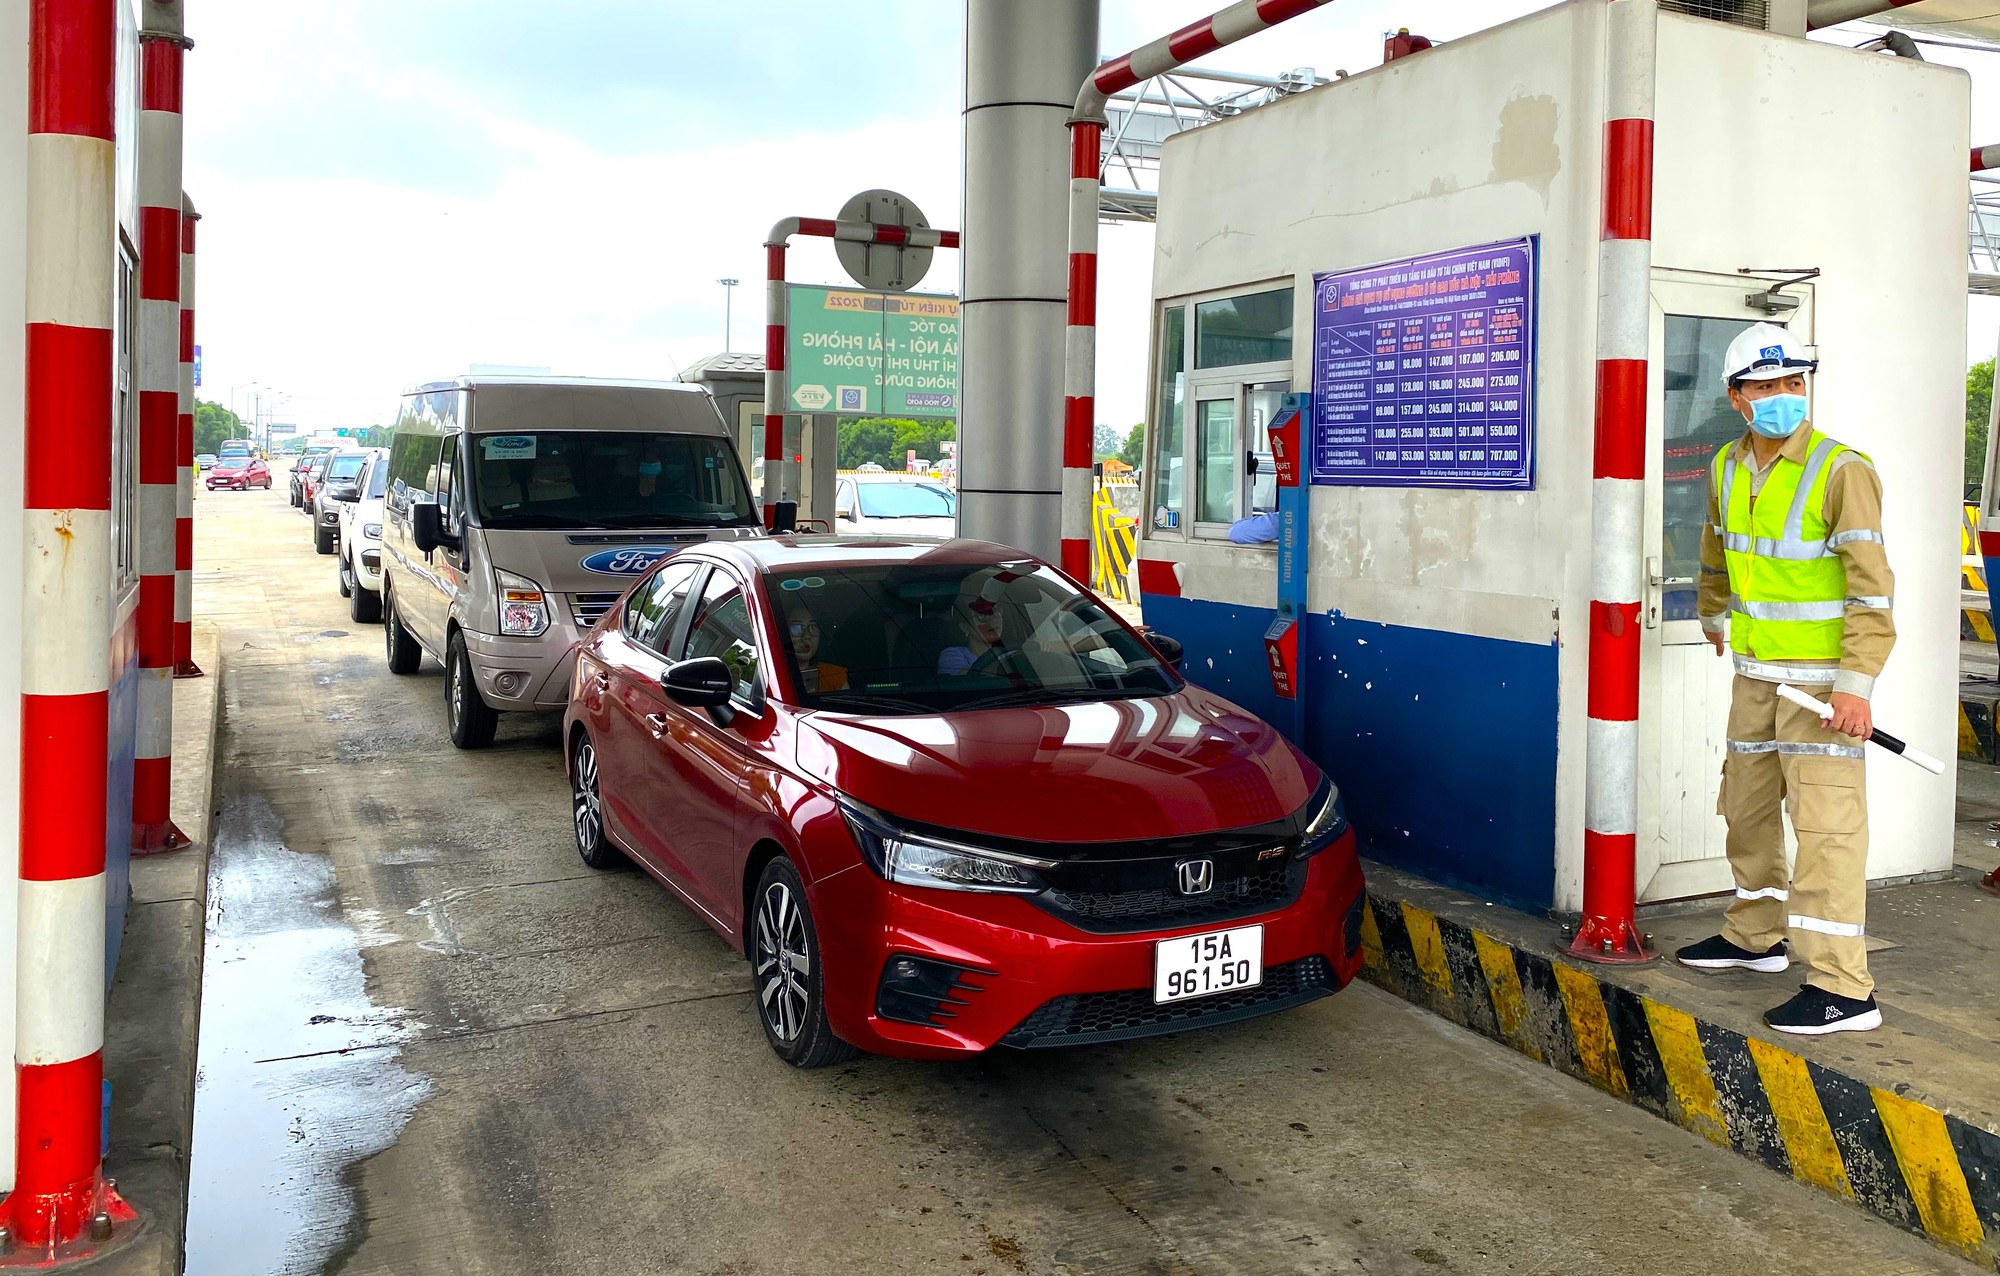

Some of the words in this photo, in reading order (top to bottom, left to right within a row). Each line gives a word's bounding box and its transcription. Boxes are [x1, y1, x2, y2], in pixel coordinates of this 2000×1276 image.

[1376, 360, 1395, 371] 39.000
[1403, 358, 1422, 369] 98.000
[1429, 355, 1453, 367] 147.000
[1459, 352, 1485, 365] 187.000
[1491, 350, 1519, 362] 206.000
[1376, 383, 1394, 394] 59.000
[1458, 377, 1484, 389] 245.000
[1490, 375, 1519, 387] 275.000
[1401, 404, 1423, 415] 157.000
[1428, 403, 1453, 414] 245.000
[1458, 401, 1484, 413] 314.000
[1490, 400, 1518, 412] 344.000
[1401, 428, 1424, 438] 255.000
[1458, 426, 1484, 437] 501.000
[1490, 425, 1518, 436] 550.000
[1375, 451, 1397, 461] 147.000
[1401, 451, 1424, 461] 353.000
[1490, 450, 1518, 461] 707.000
[1285, 511, 1293, 524] GO
[1284, 551, 1292, 583] TOUCH
[1257, 846, 1286, 861] RS
[1191, 934, 1232, 964] 15A
[1168, 960, 1249, 996] 961.50
